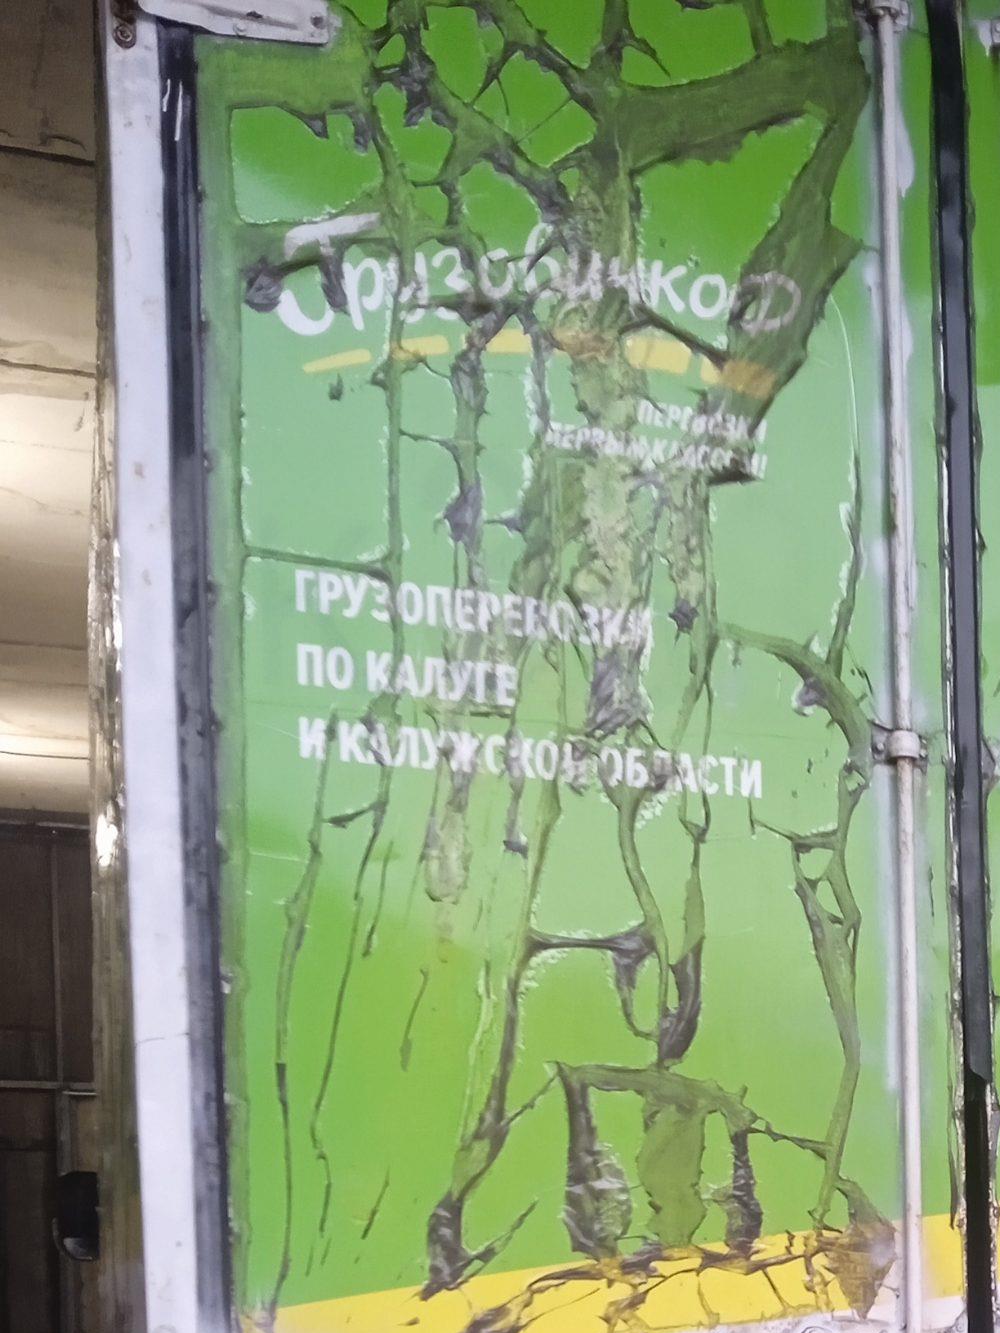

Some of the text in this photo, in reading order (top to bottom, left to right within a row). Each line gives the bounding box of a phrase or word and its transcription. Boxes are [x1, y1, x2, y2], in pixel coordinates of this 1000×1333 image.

[294, 569, 653, 649] ГРУЗОПЕРЕВОЗКИ
[296, 643, 518, 708] ПО КАЛУГЕ
[298, 717, 328, 760] И
[599, 746, 763, 799] ОБЛАСТИ
